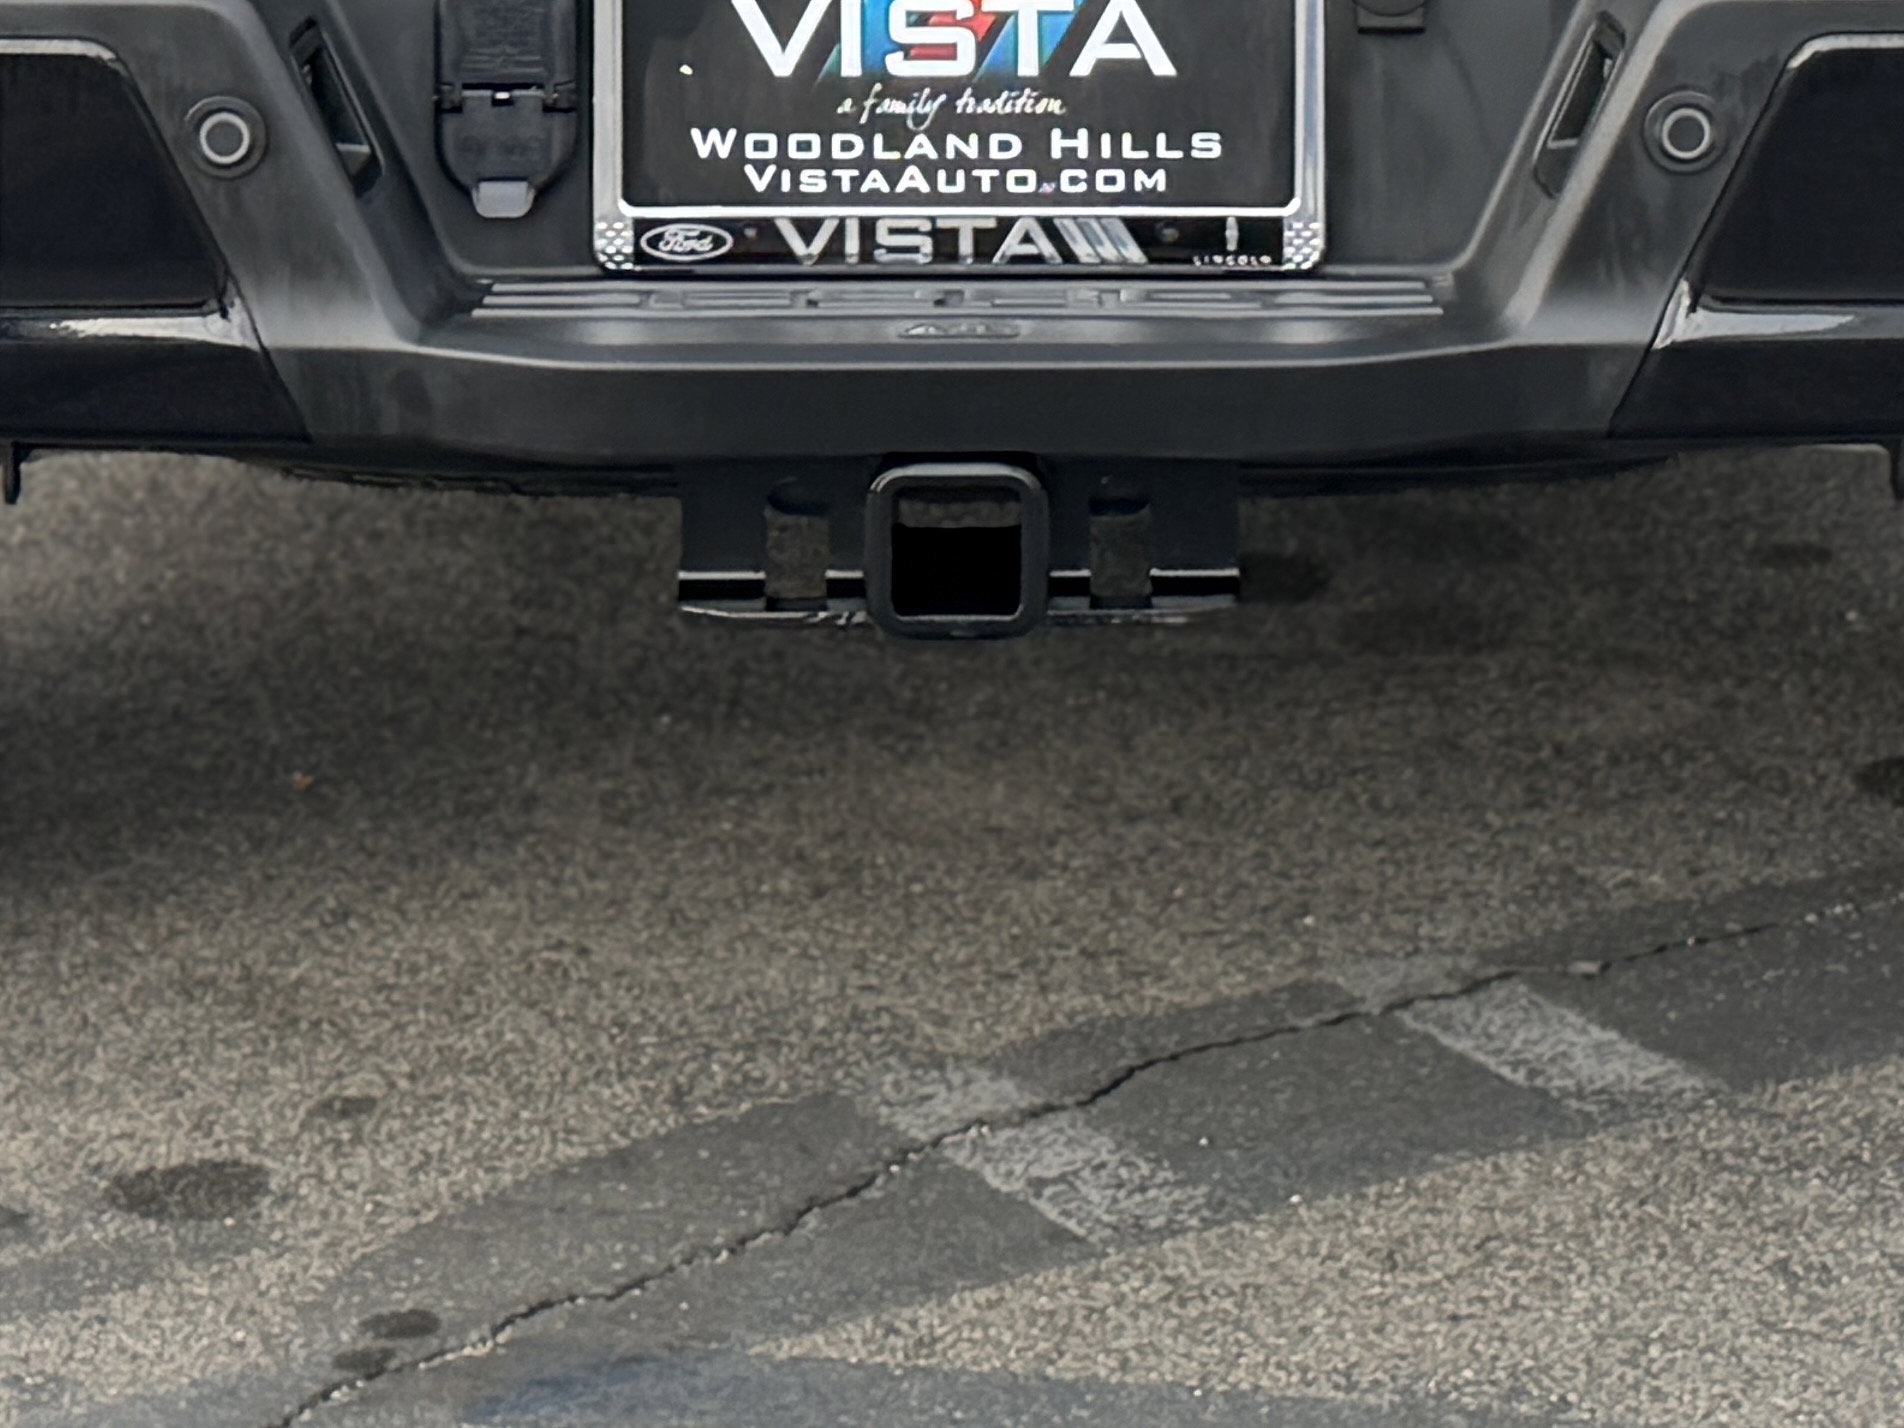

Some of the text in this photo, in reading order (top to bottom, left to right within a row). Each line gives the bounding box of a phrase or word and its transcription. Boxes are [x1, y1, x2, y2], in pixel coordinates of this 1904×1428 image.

[859, 82, 947, 132] family
[955, 86, 1067, 115] tradition
[690, 127, 1223, 160] WOODLAND HILLS
[773, 216, 1064, 265] VISTA
